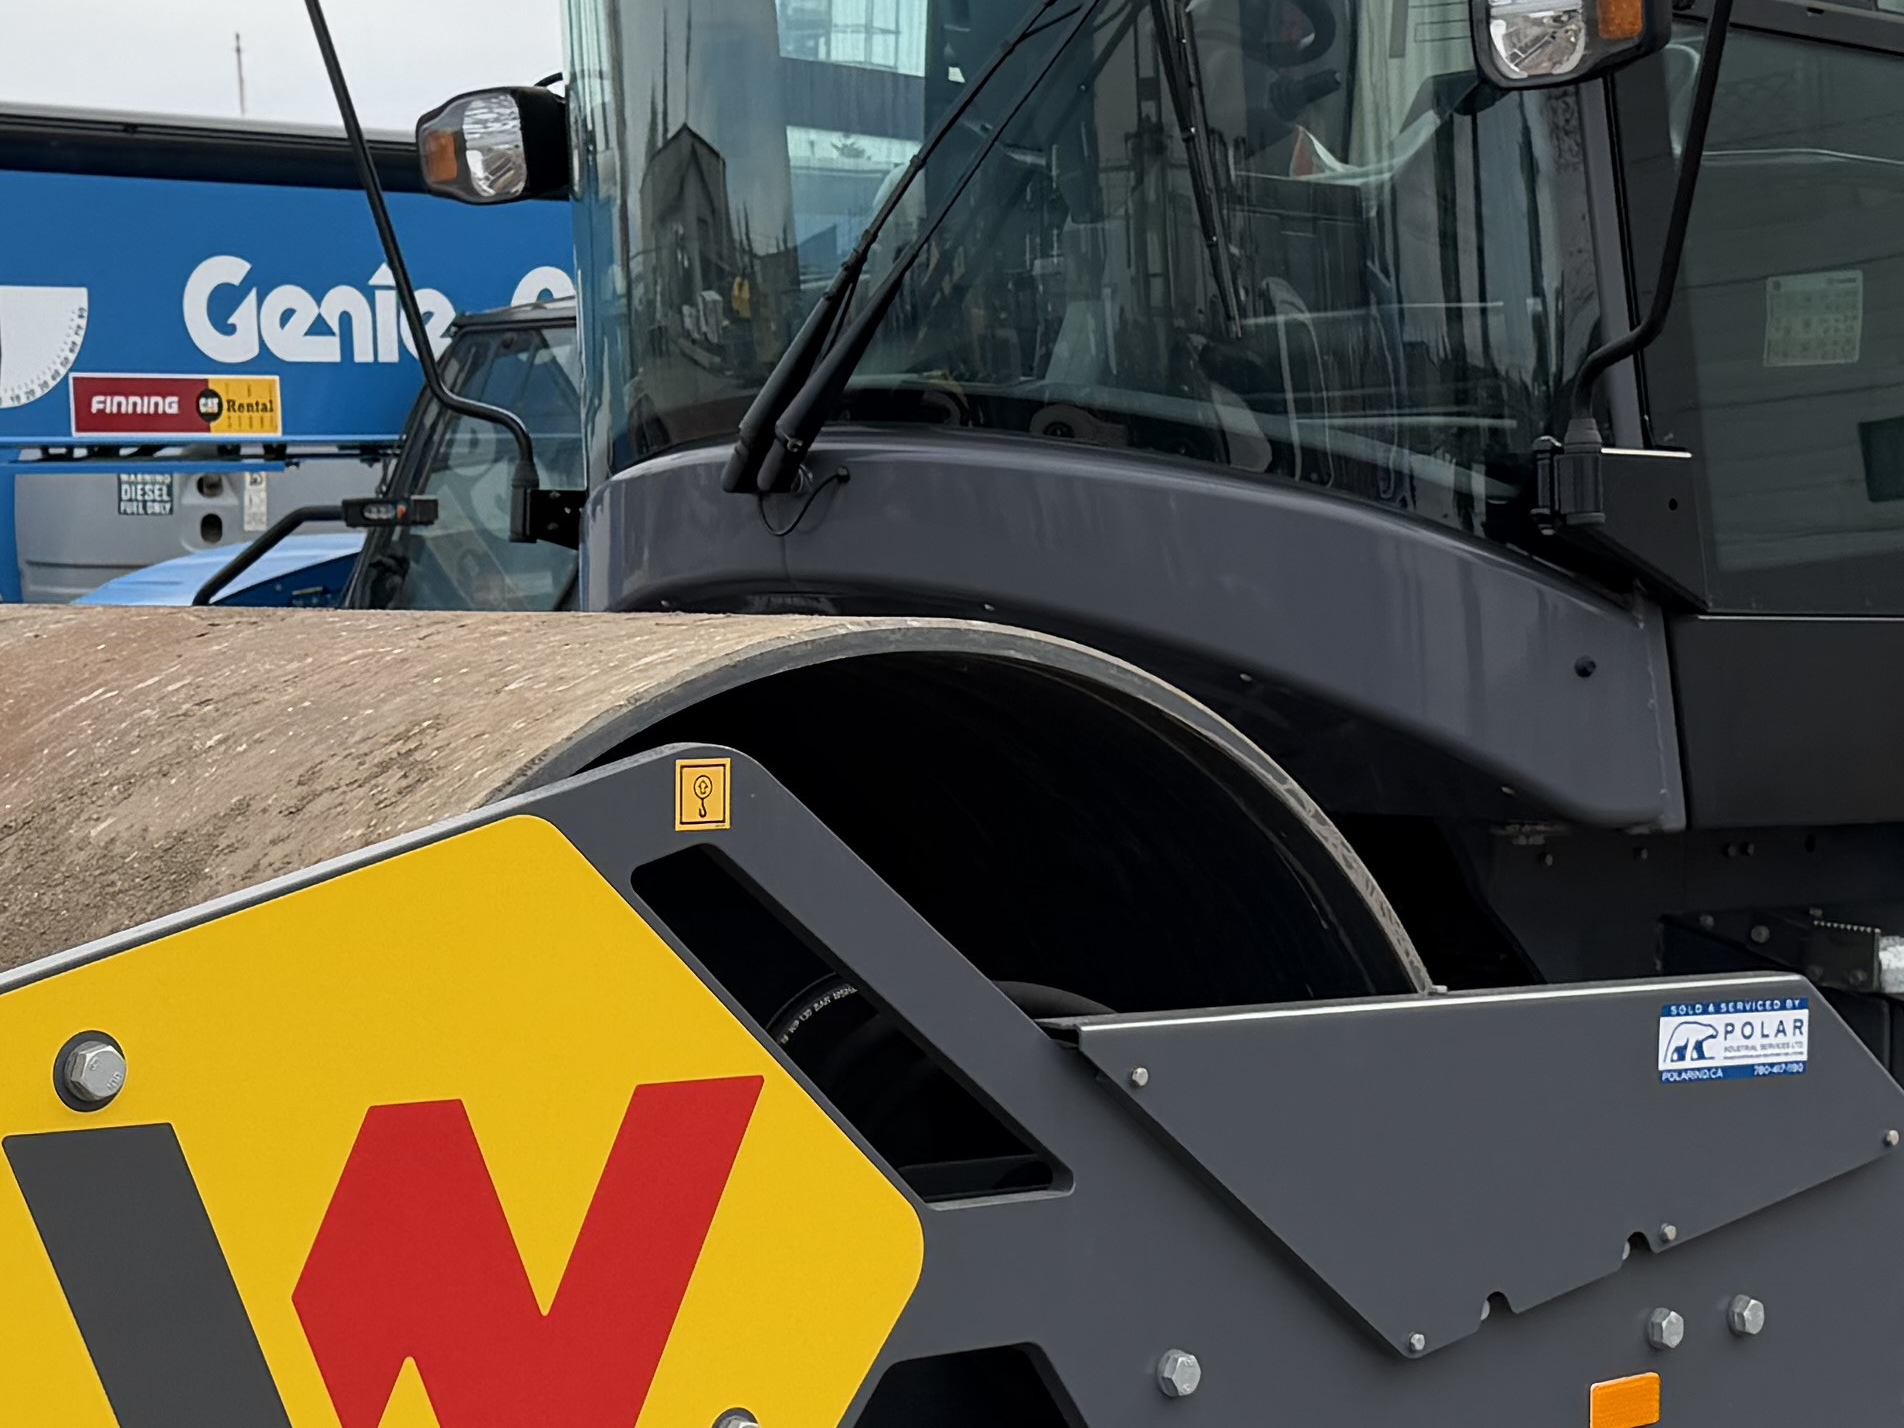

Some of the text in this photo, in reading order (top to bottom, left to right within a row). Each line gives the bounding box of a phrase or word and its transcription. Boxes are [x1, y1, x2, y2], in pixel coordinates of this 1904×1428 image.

[182, 254, 458, 364] Genie
[91, 395, 180, 414] FINNING
[227, 399, 274, 414] Rental
[121, 485, 170, 500] DIESEL
[120, 501, 171, 514] FUEL ONLY
[1670, 1004, 1702, 1015] SOLD
[1720, 1001, 1781, 1012] SERVICED
[1786, 999, 1800, 1008] BY
[1724, 1018, 1804, 1041] POLAR
